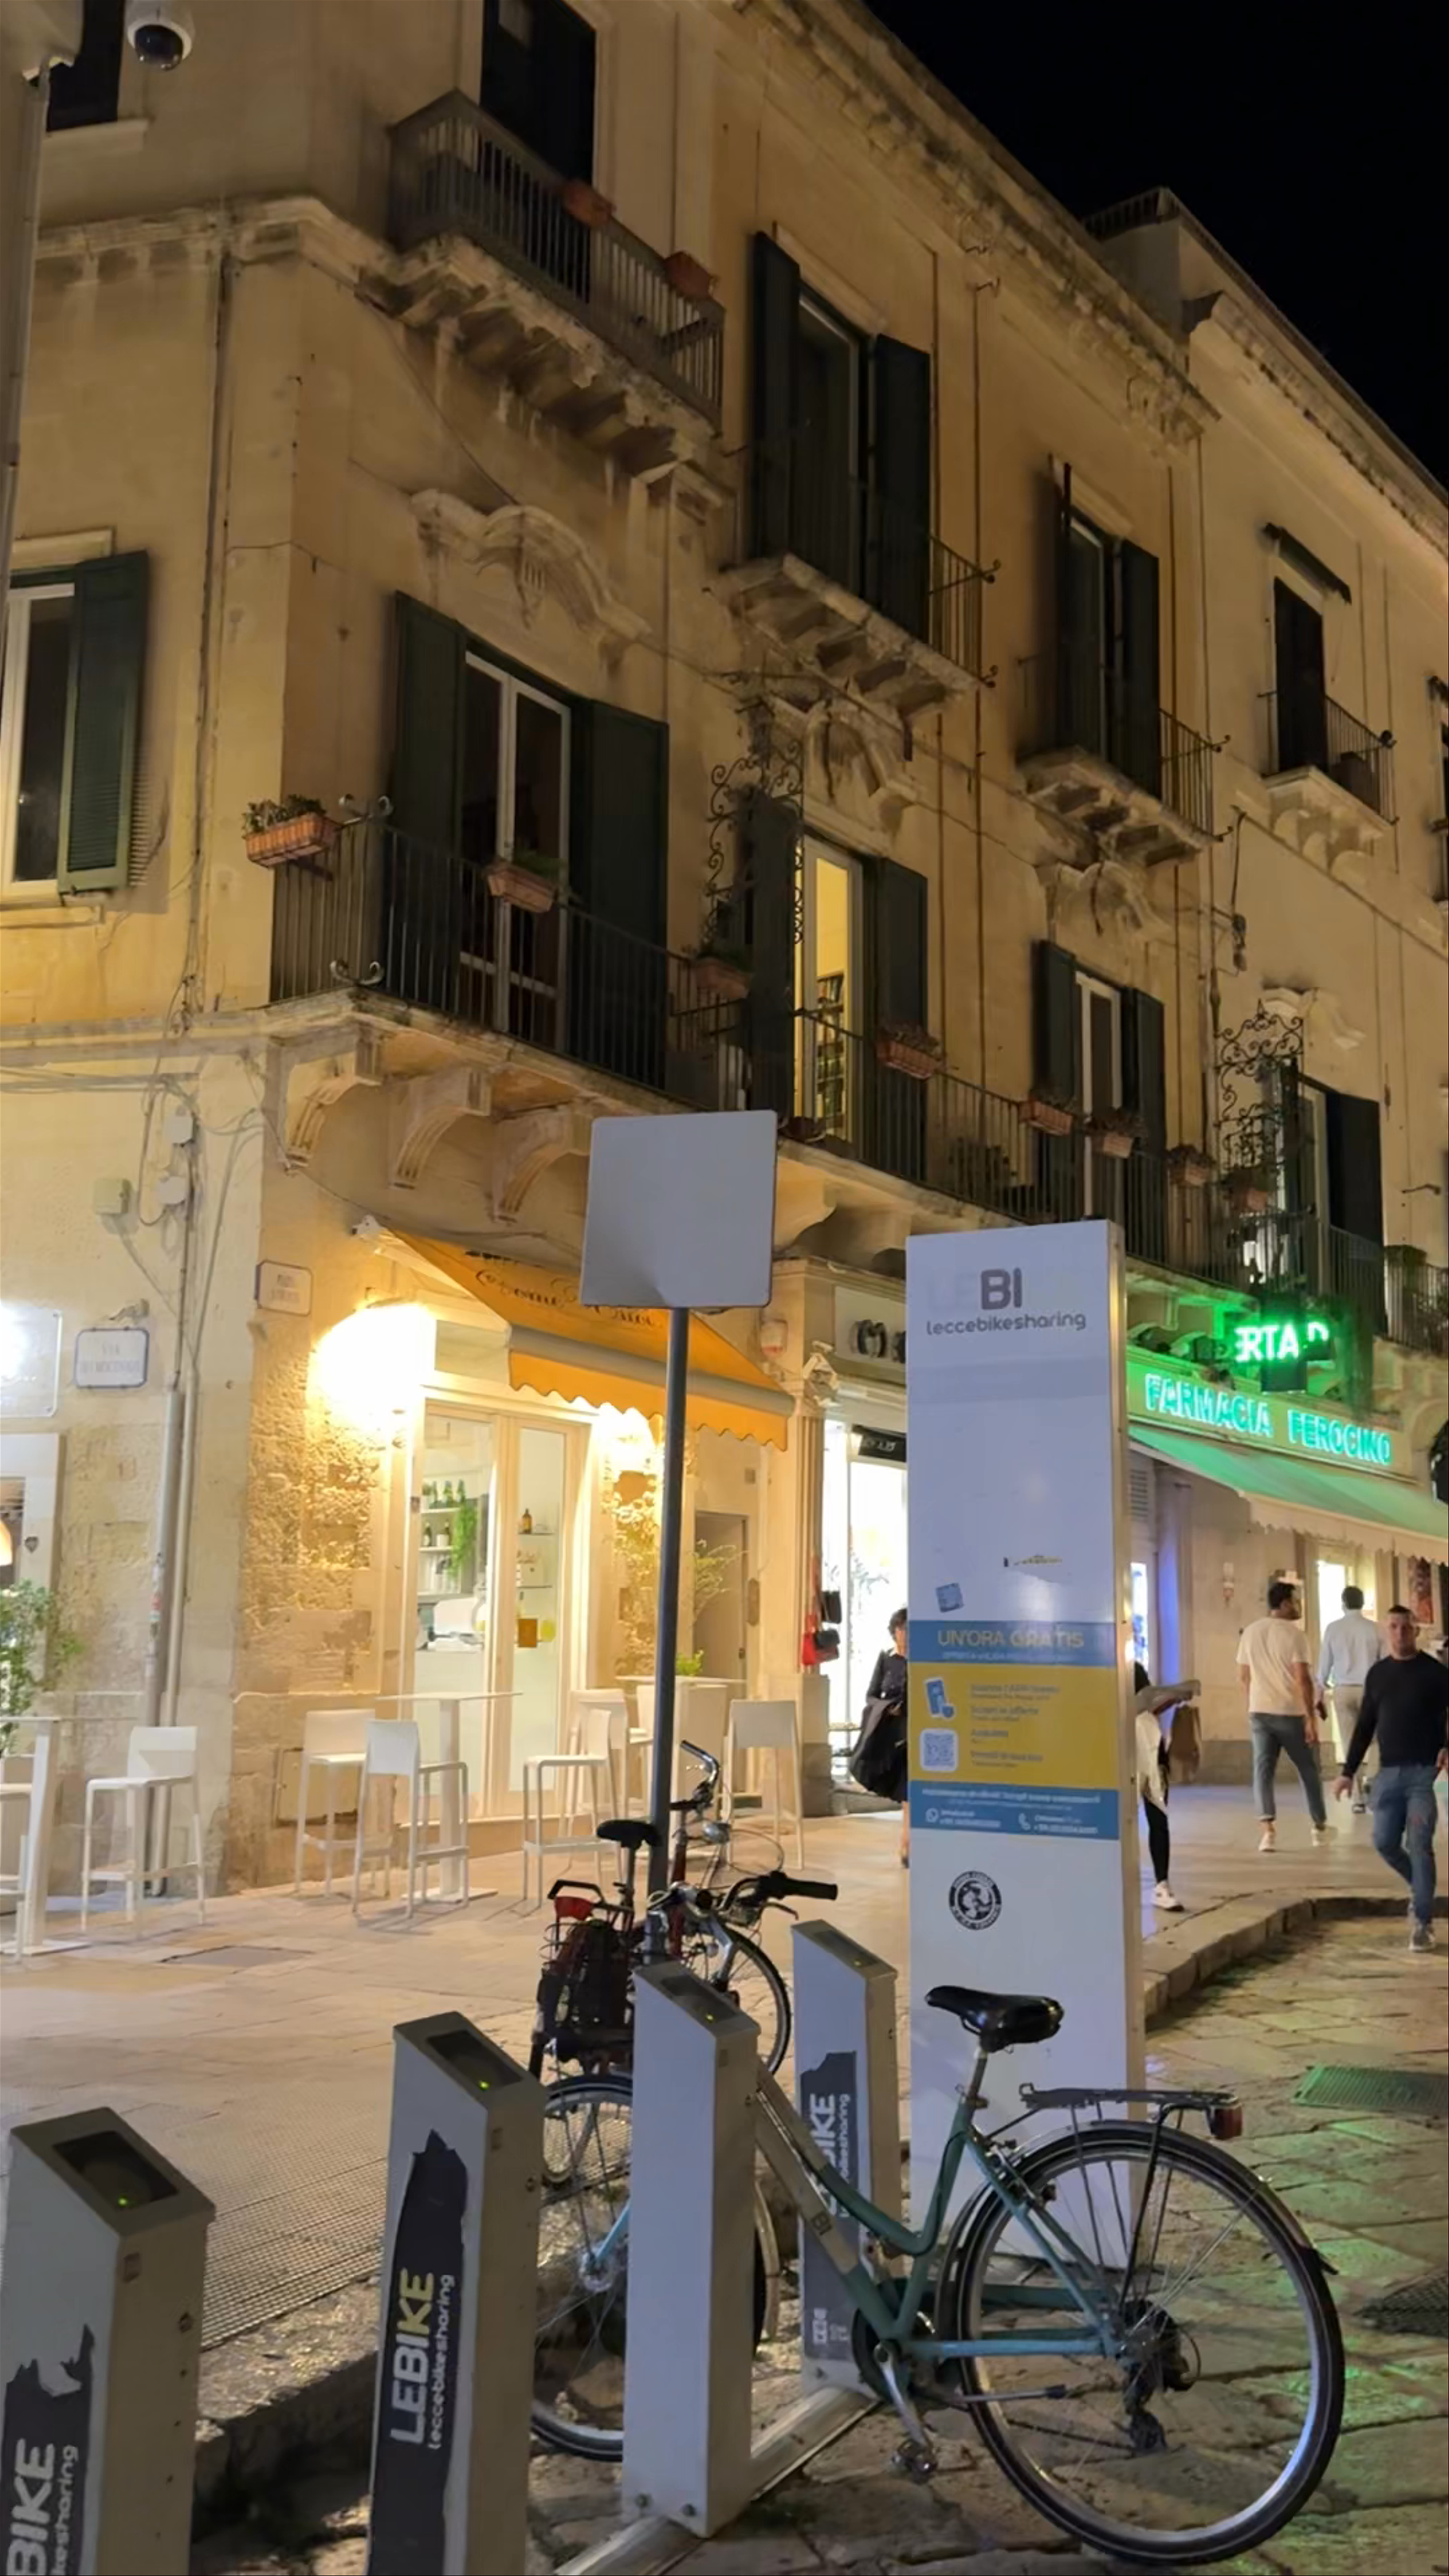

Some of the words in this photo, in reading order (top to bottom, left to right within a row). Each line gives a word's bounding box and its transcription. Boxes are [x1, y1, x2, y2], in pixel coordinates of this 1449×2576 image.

[926, 1312, 1086, 1335] leccebikesharing
[1145, 1373, 1273, 1438] FARMACIA
[938, 1630, 1005, 1646] UN'ORA
[1009, 1630, 1084, 1648] GRATIS
[390, 2267, 434, 2444] LEBIKE
[428, 2274, 455, 2449] leccebikesharing
